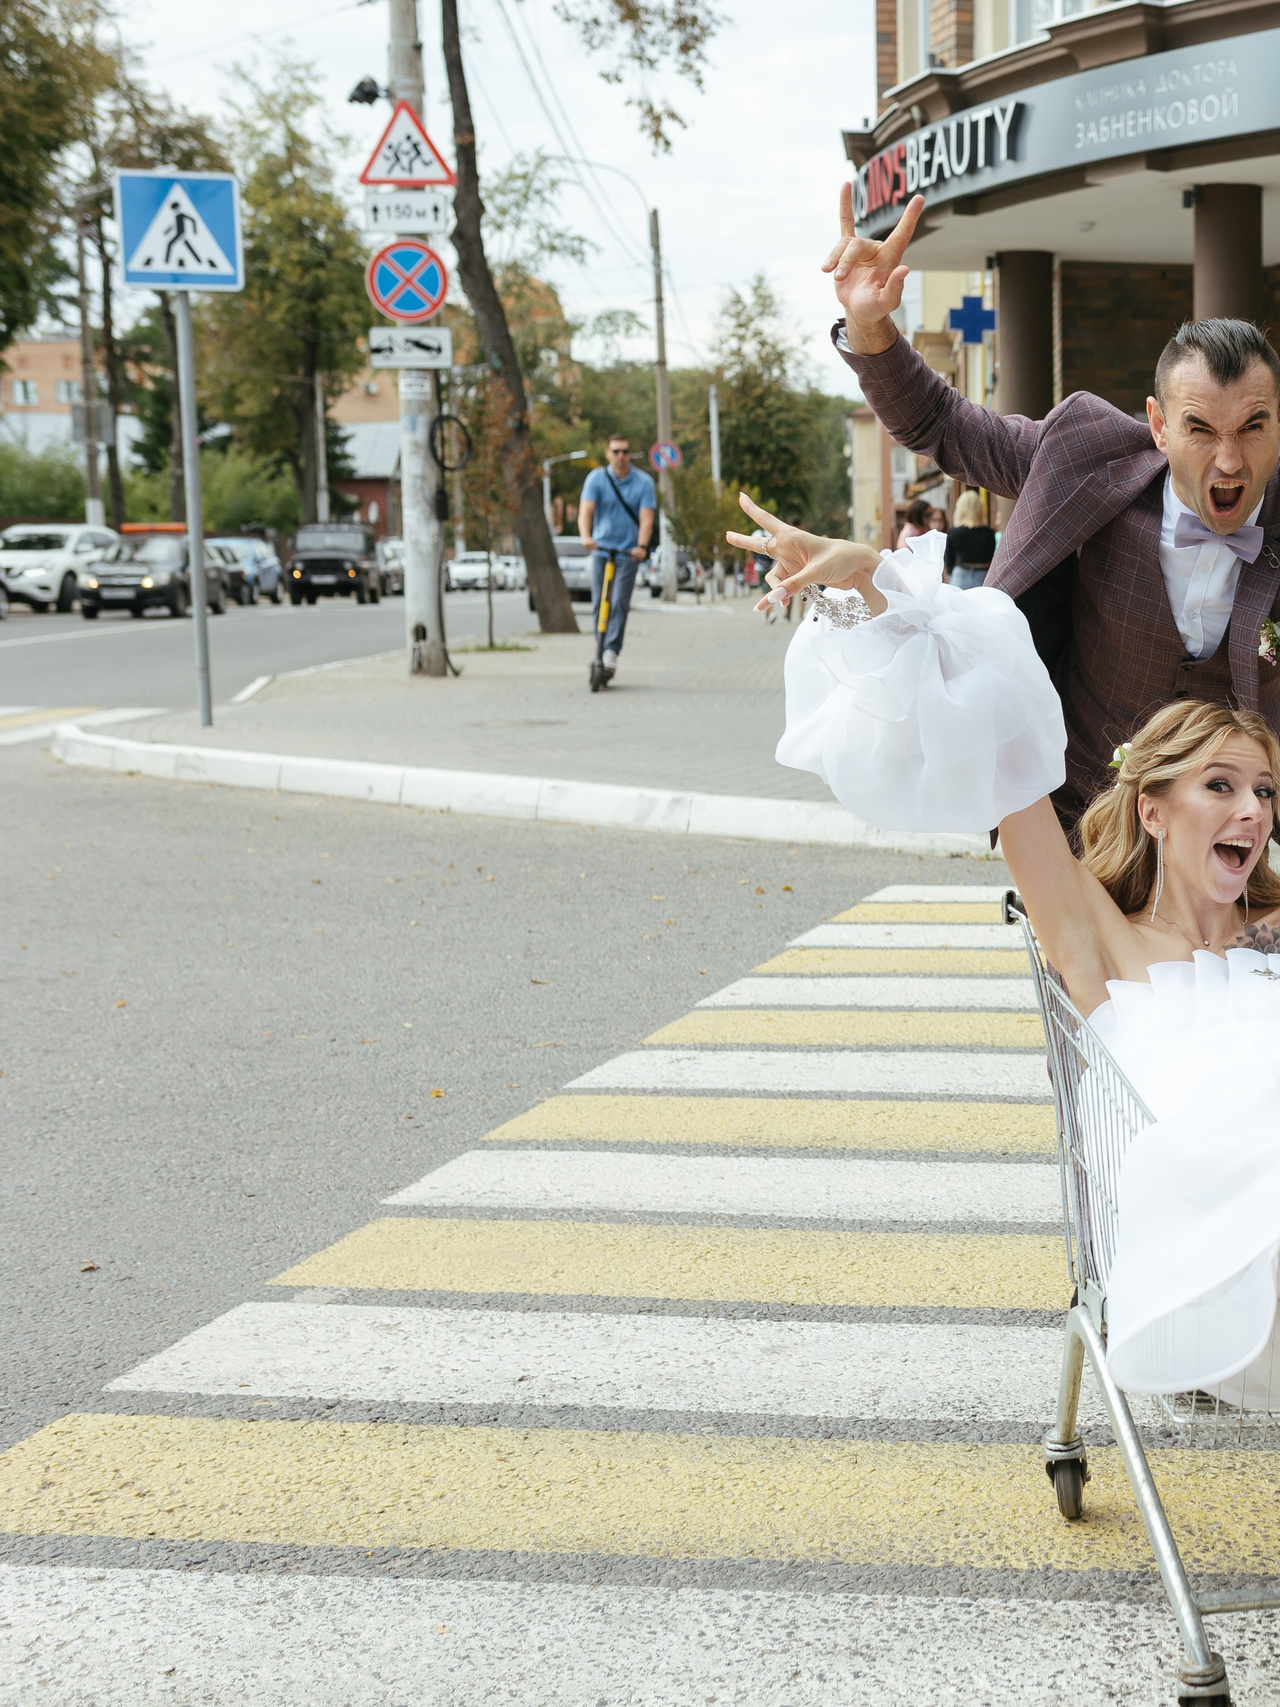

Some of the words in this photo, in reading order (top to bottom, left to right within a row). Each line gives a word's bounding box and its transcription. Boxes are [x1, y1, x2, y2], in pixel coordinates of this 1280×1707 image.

[1074, 86, 1239, 149] ЗАБНЕНКОВОЙ
[851, 100, 1018, 223] OSMOSBEAUTY
[386, 203, 413, 220] 150
